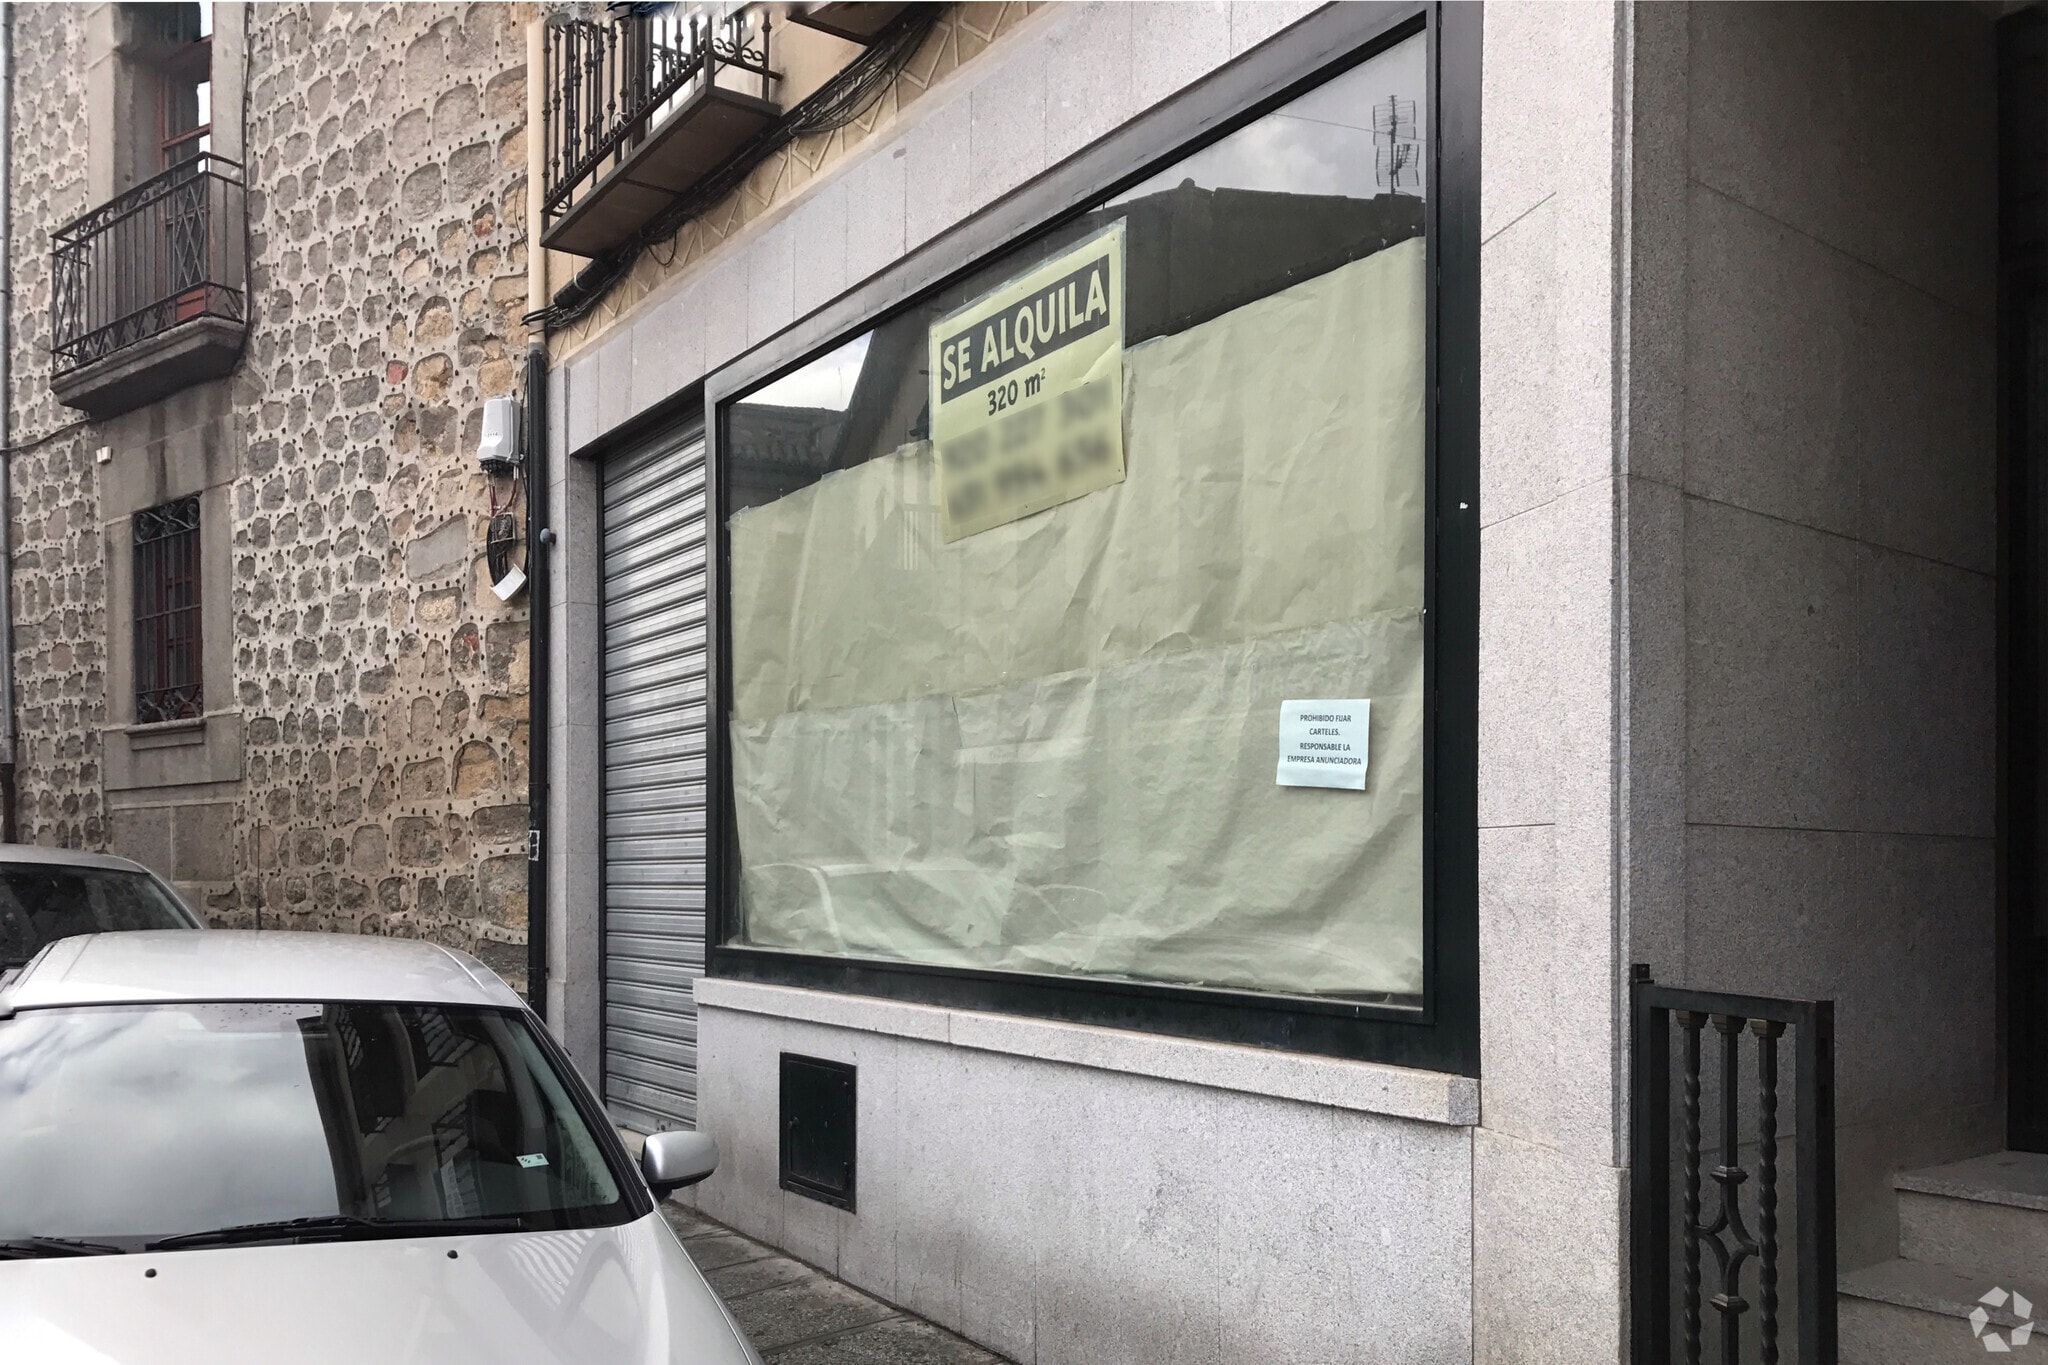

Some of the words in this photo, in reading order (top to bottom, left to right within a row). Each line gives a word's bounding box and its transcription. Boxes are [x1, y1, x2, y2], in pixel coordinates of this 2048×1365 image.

[943, 336, 972, 390] SE
[980, 269, 1107, 373] ALQUILA
[987, 379, 1019, 417] 320
[1300, 714, 1335, 722] PROHIBIDO
[1335, 714, 1351, 722] FIJAR
[1309, 728, 1341, 736] CARTELES.
[1300, 742, 1342, 751] RESPONSABLE
[1343, 743, 1351, 751] LA
[1287, 755, 1315, 763] EMPRESA
[1316, 756, 1362, 765] ANUNCIADORA
